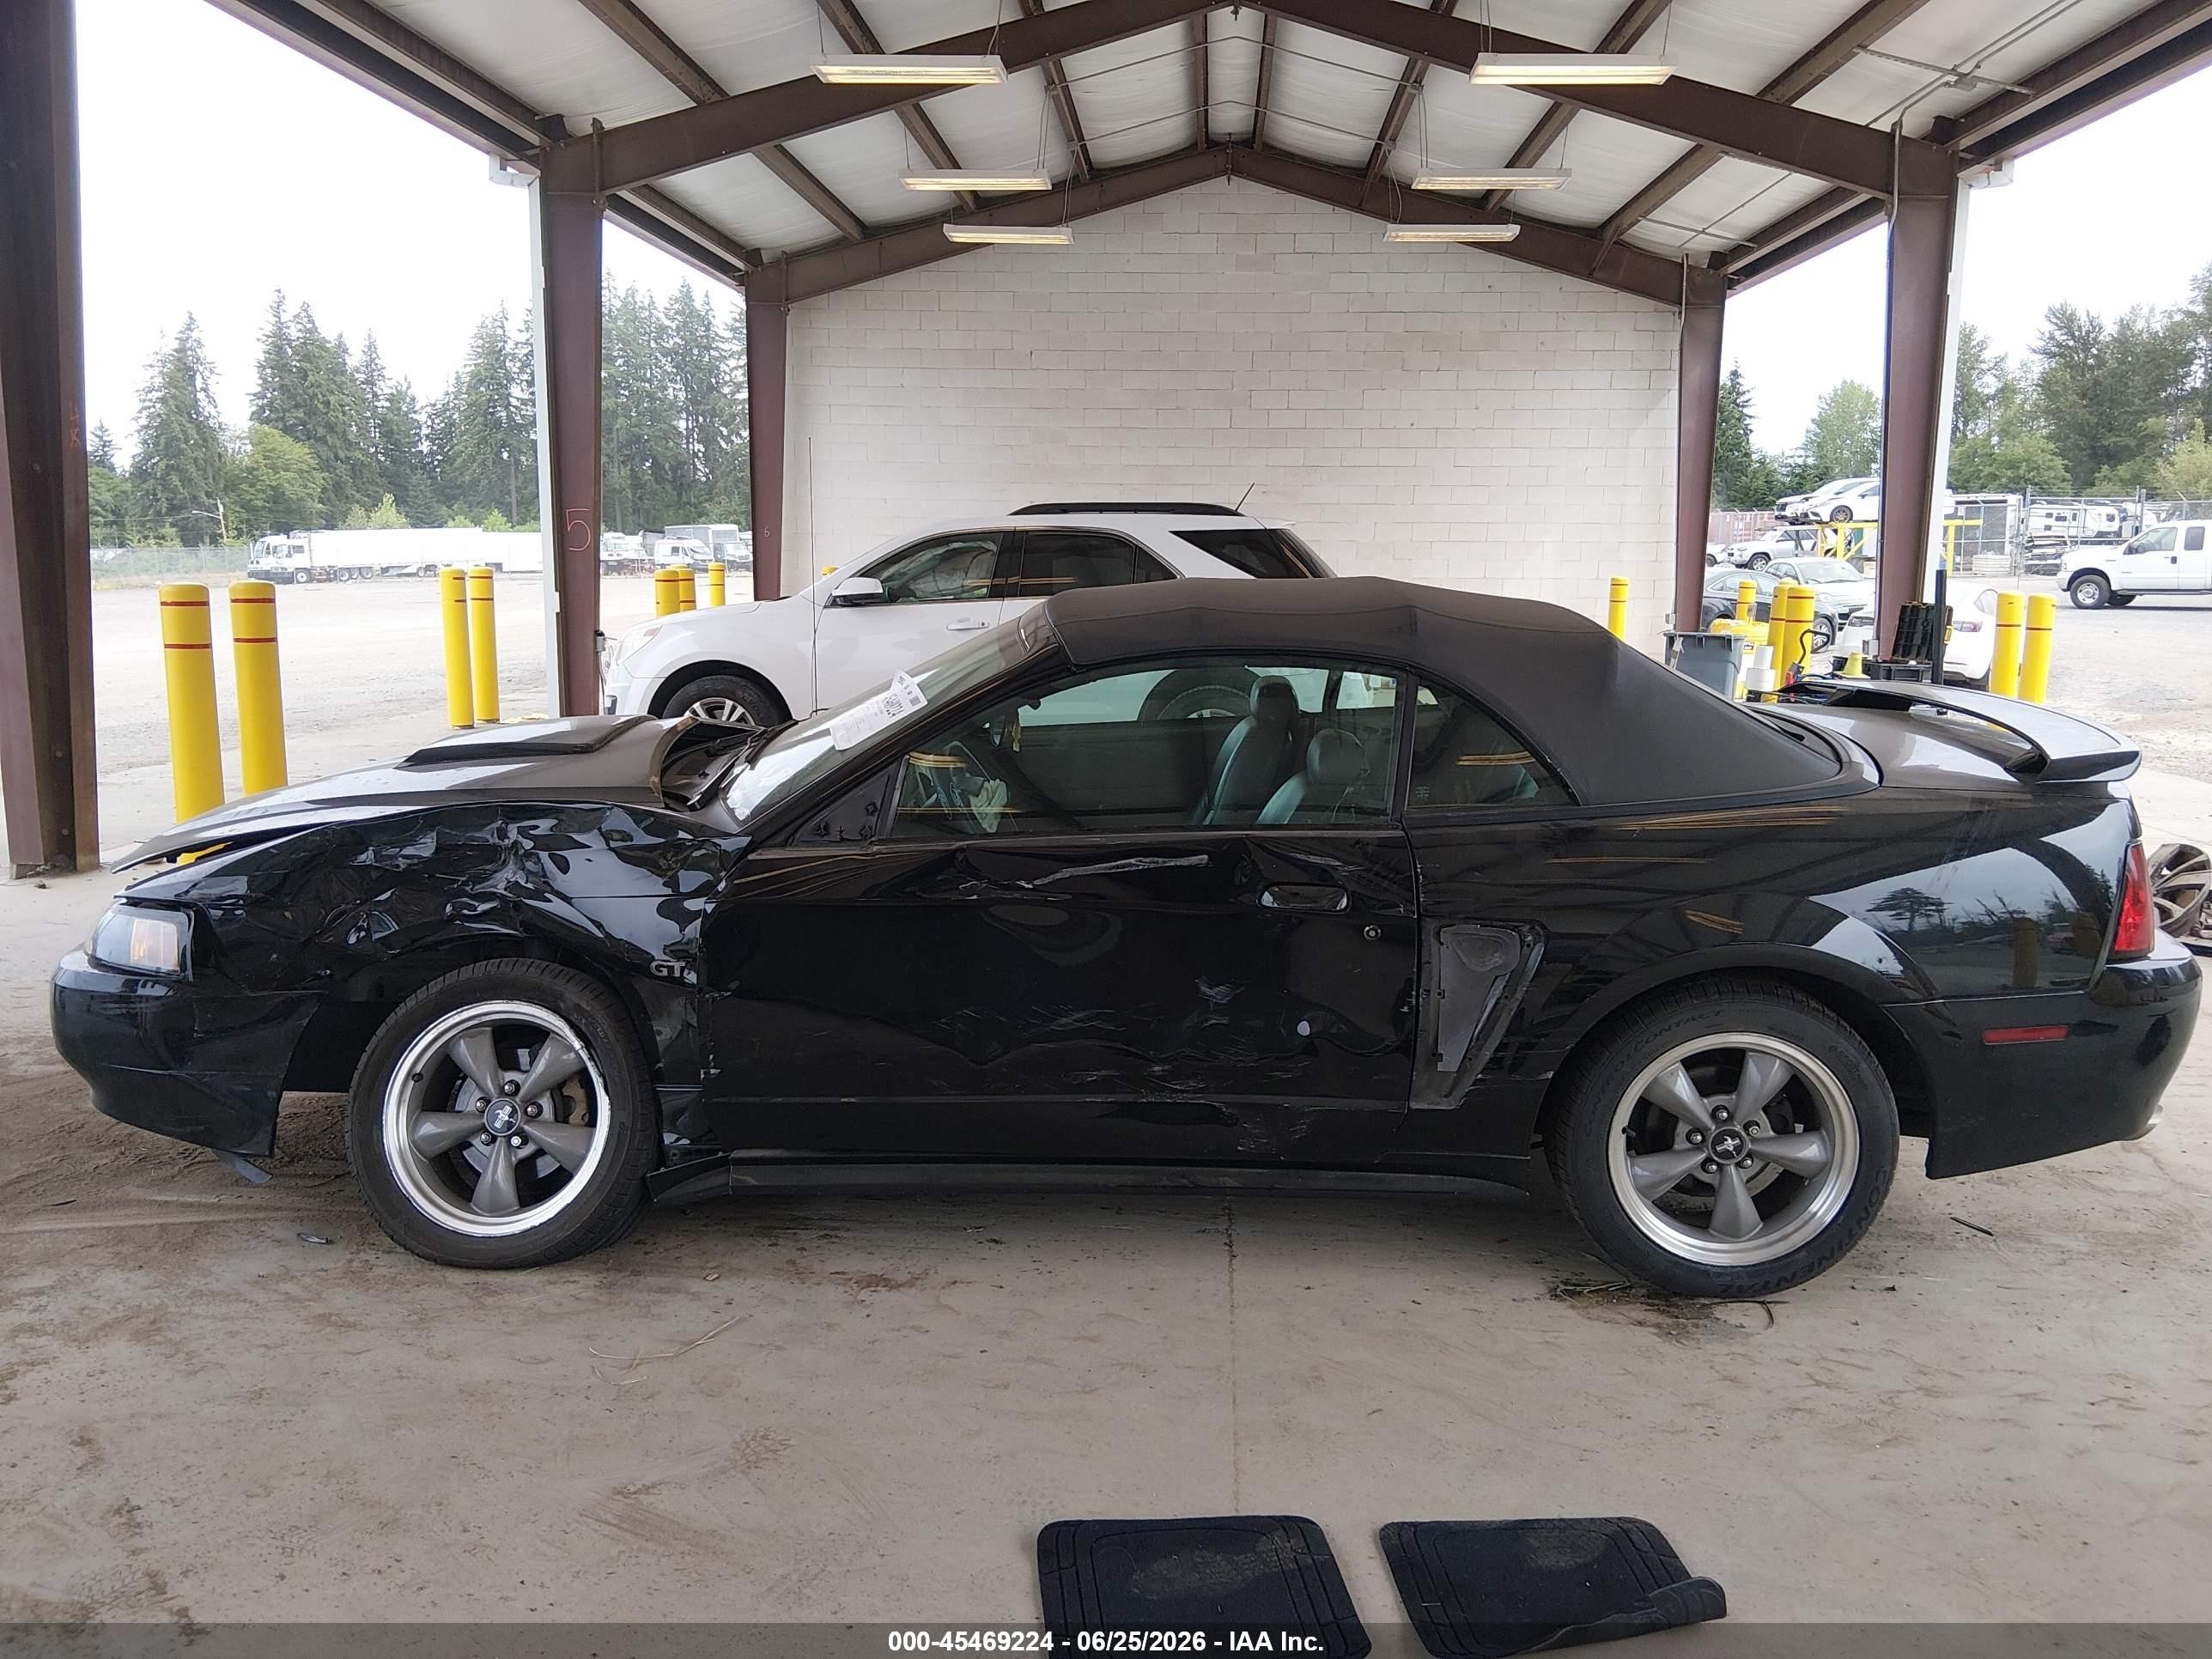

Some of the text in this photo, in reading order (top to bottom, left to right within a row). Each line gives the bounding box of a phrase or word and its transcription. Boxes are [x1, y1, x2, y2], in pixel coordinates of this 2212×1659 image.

[566, 508, 592, 551] 5
[763, 526, 770, 538] 6
[649, 960, 686, 977] GT
